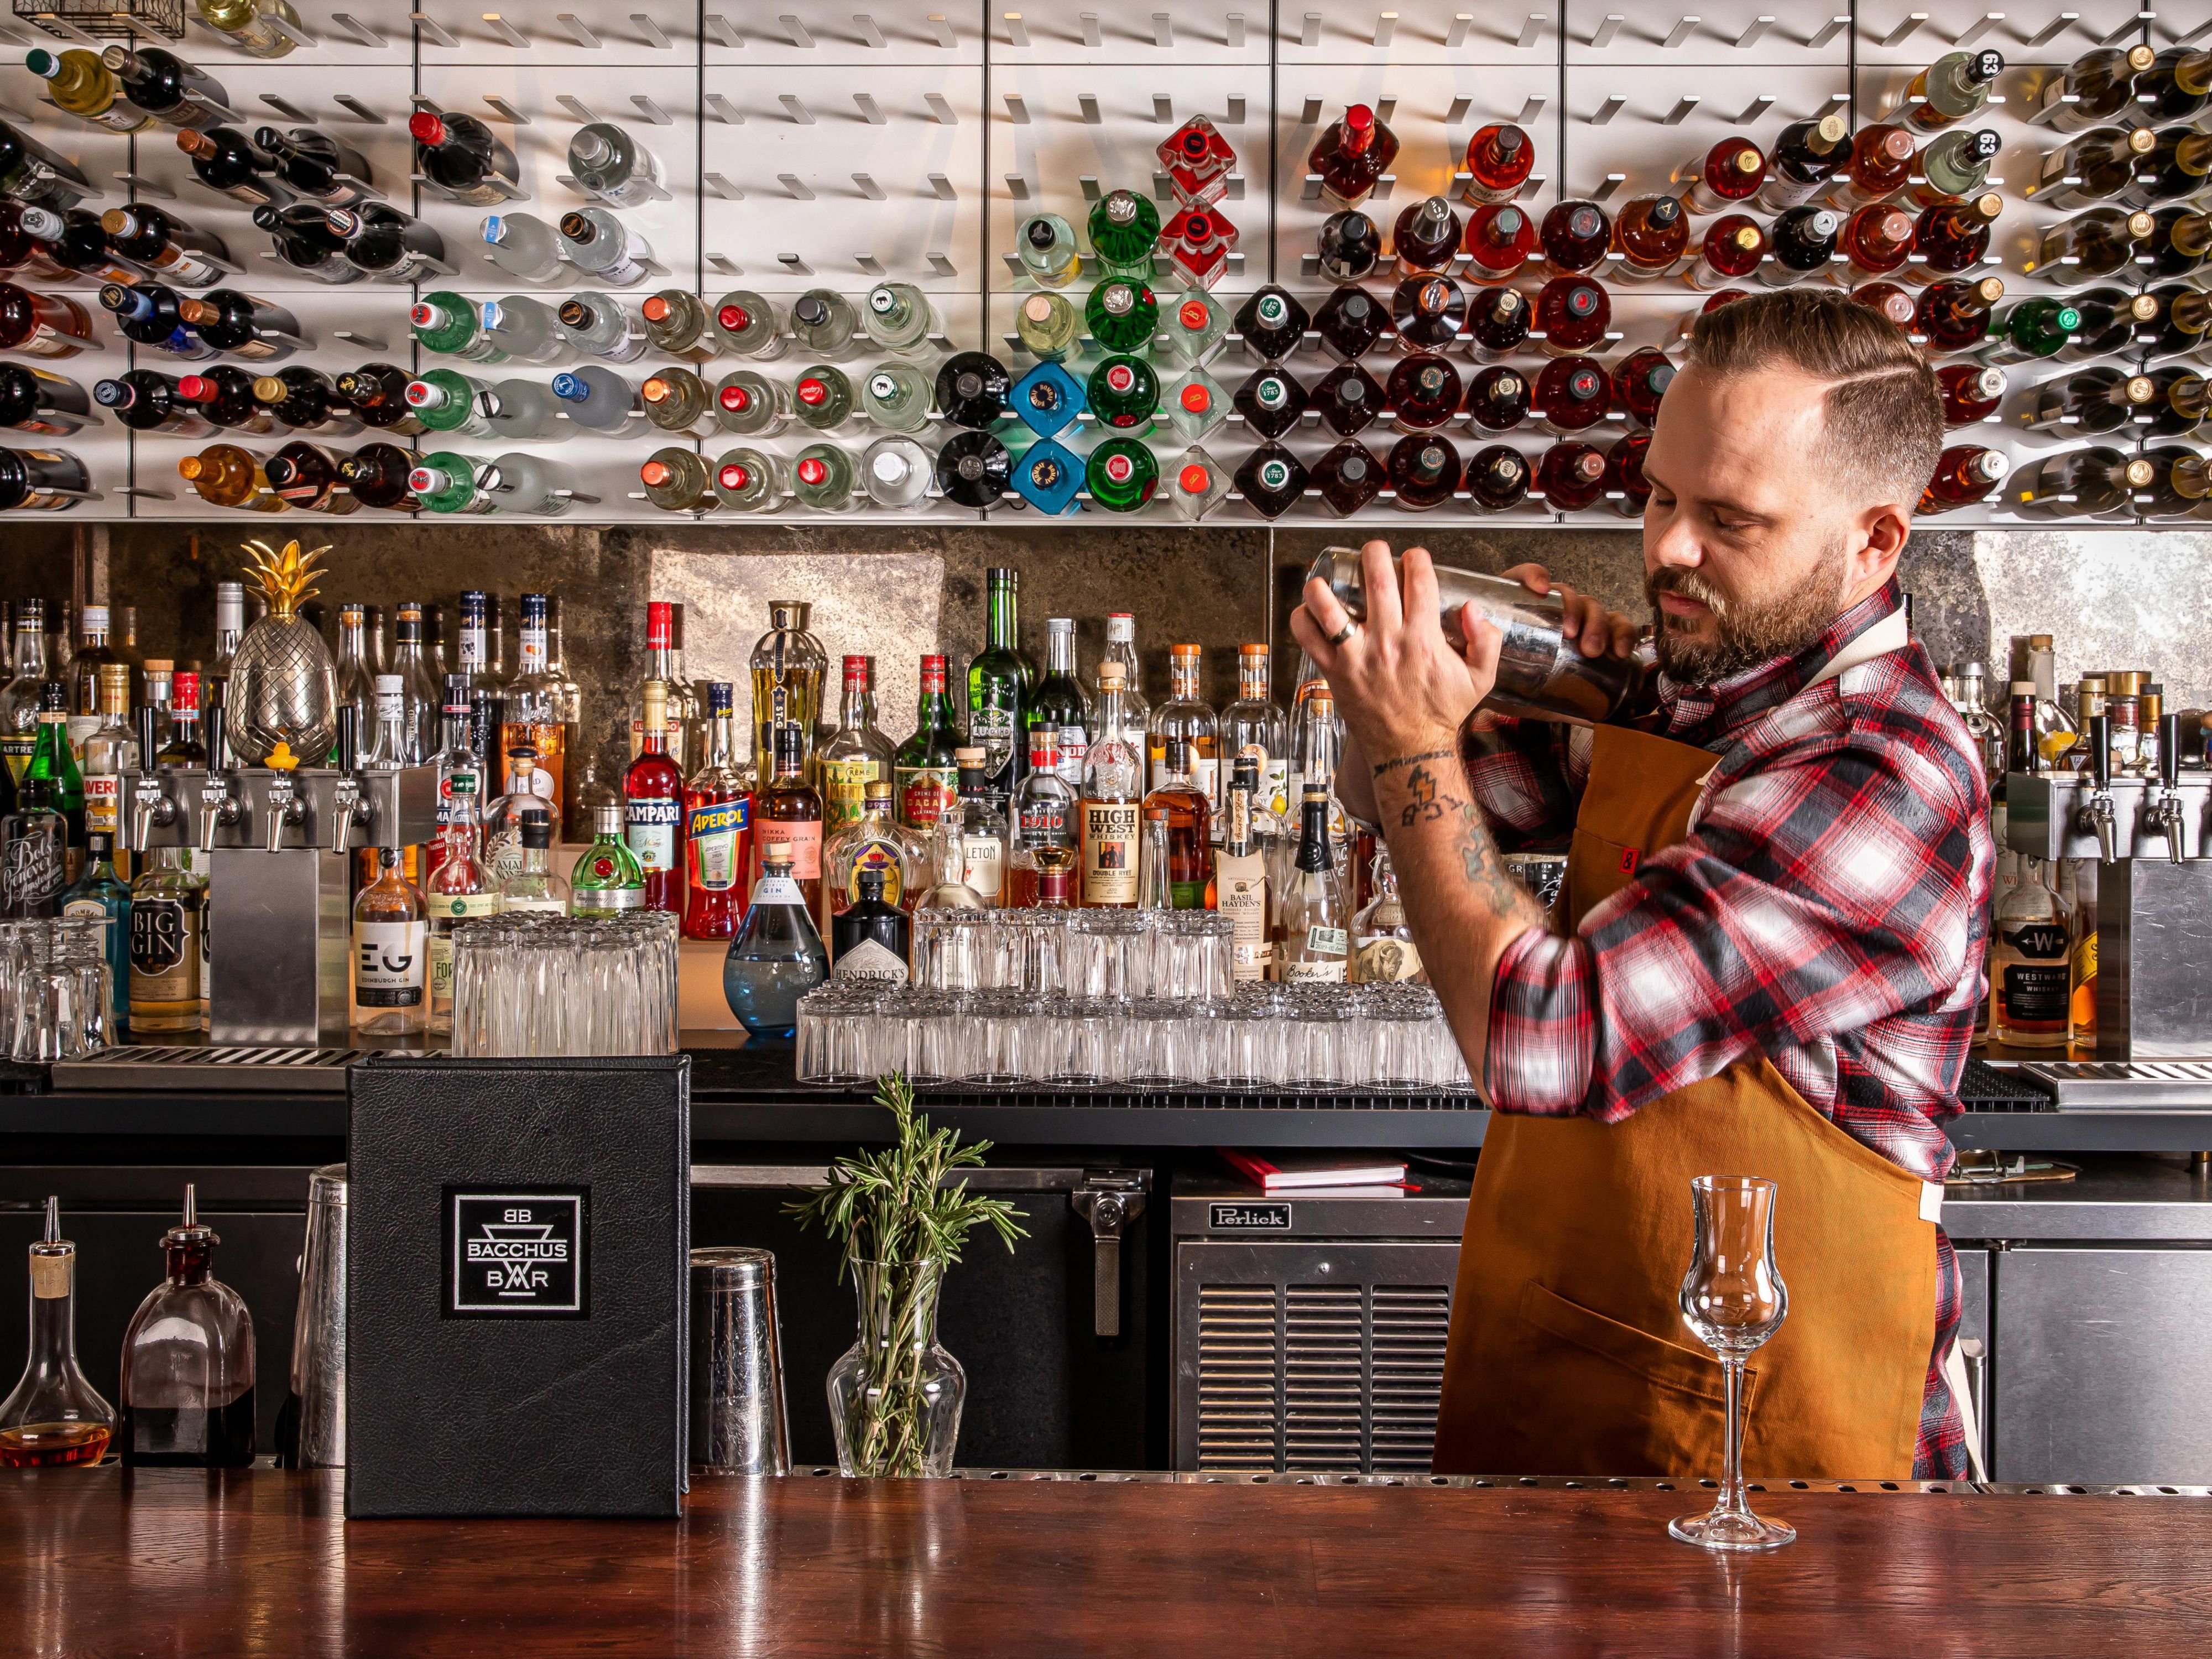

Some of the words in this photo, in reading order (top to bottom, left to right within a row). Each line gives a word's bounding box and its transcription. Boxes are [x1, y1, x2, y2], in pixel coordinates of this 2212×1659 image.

[1983, 54, 1999, 74] 63
[1980, 134, 1996, 154] 63
[332, 211, 351, 226] CARPANO
[1267, 301, 1278, 316] 1783
[1031, 389, 1045, 407] BOMBAY
[1040, 384, 1053, 403] BOMBAY
[1034, 462, 1045, 483] BOMBAY
[1045, 464, 1056, 485] BOMBAY
[972, 726, 1013, 737] LUCID
[3, 745, 34, 754] ARTRE
[830, 783, 865, 798] MENT
[625, 806, 679, 822] CAMPARI
[692, 809, 744, 834] APEROL
[1089, 810, 1135, 825] HIGH
[1020, 815, 1063, 829] 1910
[1089, 824, 1135, 834] WEST
[966, 845, 995, 860] LETON
[576, 893, 609, 904] Tanqueray
[134, 912, 175, 933] BIG
[132, 933, 176, 954] GIN
[2033, 932, 2054, 951] W
[836, 968, 905, 980] HENDRICK'S
[1287, 964, 1333, 978] Booker's
[1215, 1208, 1284, 1225] Perlick
[468, 1244, 567, 1257] BACCHUS
[487, 1264, 549, 1290] BAR
